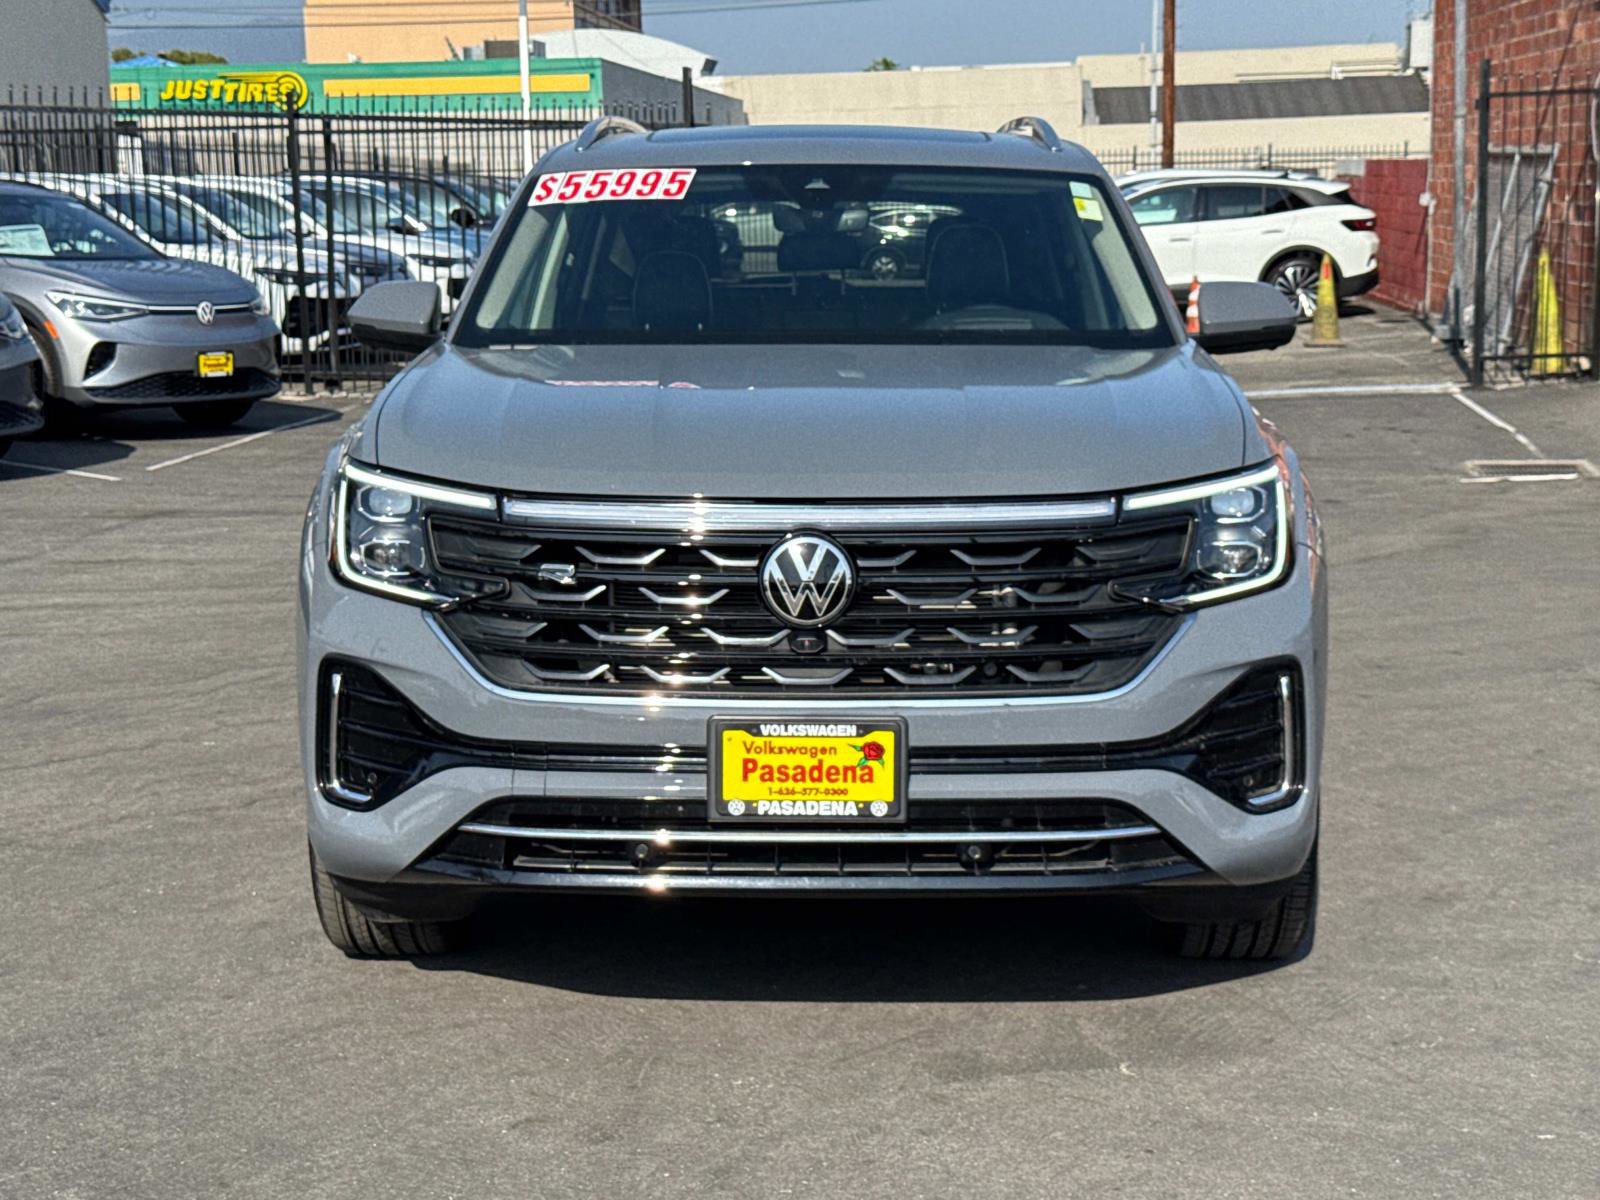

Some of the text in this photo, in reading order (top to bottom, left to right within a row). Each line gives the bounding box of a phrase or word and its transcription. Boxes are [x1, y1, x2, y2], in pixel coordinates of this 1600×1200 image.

[160, 79, 226, 101] JUST
[534, 171, 692, 203] $55995
[760, 724, 857, 737] VOLKSWAGEN
[743, 741, 837, 758] Volkswagen
[742, 758, 874, 783] Pasadena
[757, 800, 858, 816] PASADENA
